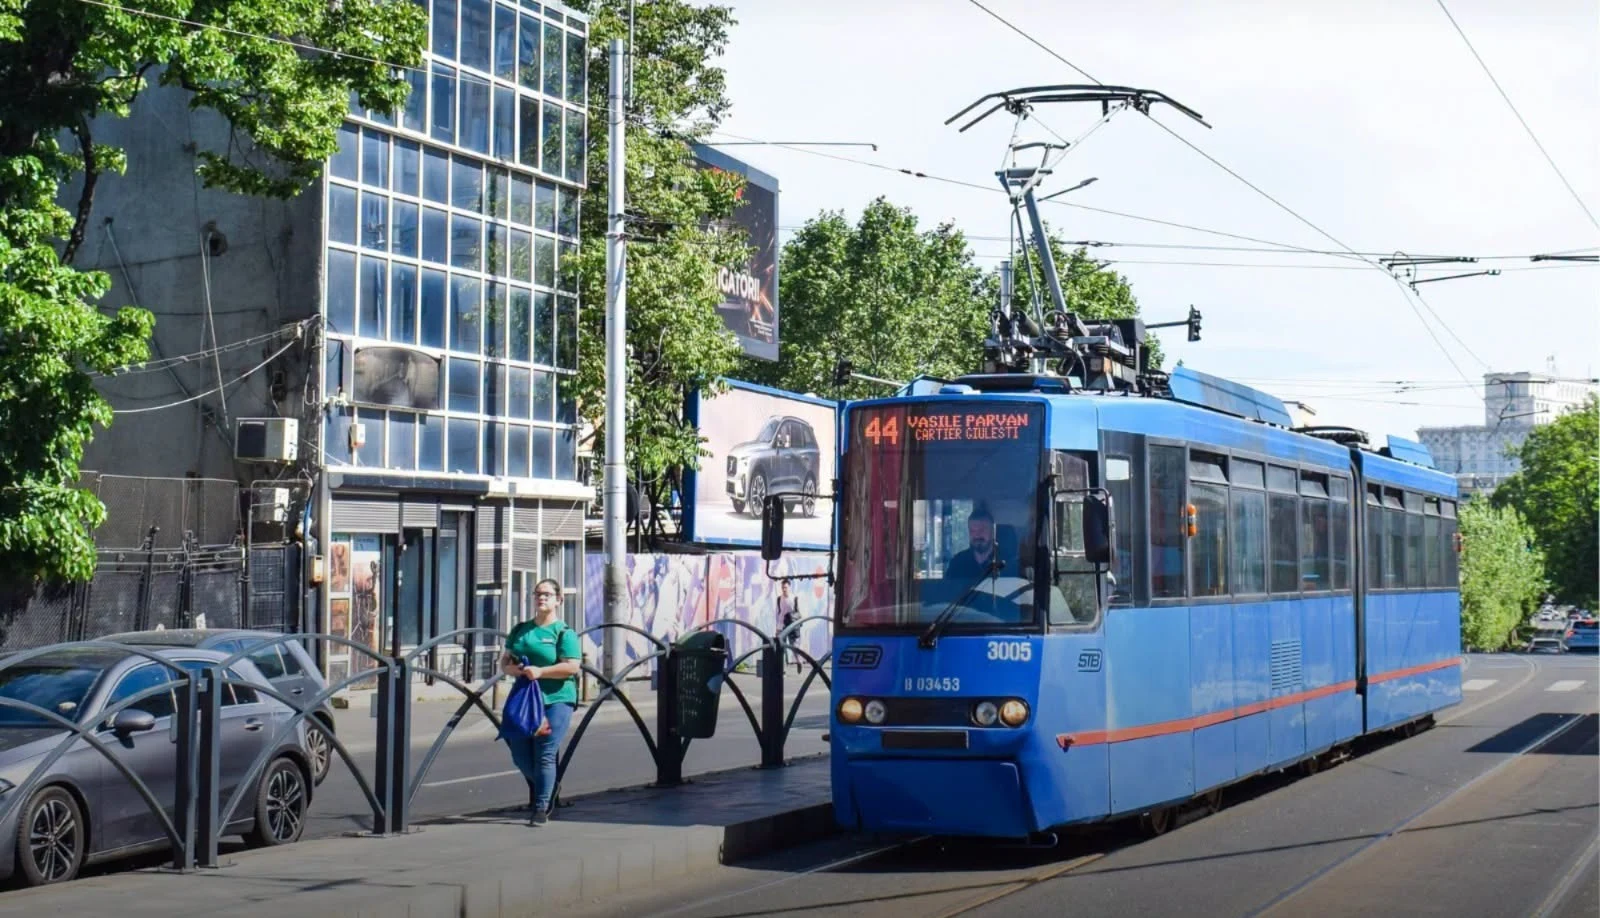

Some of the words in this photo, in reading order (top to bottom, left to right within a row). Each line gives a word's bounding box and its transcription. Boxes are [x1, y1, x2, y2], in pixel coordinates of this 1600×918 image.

[907, 414, 962, 428] VASILE
[966, 413, 1029, 427] PARVAN
[864, 416, 898, 445] 44
[915, 427, 962, 441] CARTIER
[966, 426, 1019, 440] GIULESTI
[838, 649, 881, 666] STB
[987, 640, 1032, 662] 3005
[1077, 652, 1101, 669] STB
[904, 677, 913, 691] B
[917, 677, 961, 692] 03453
